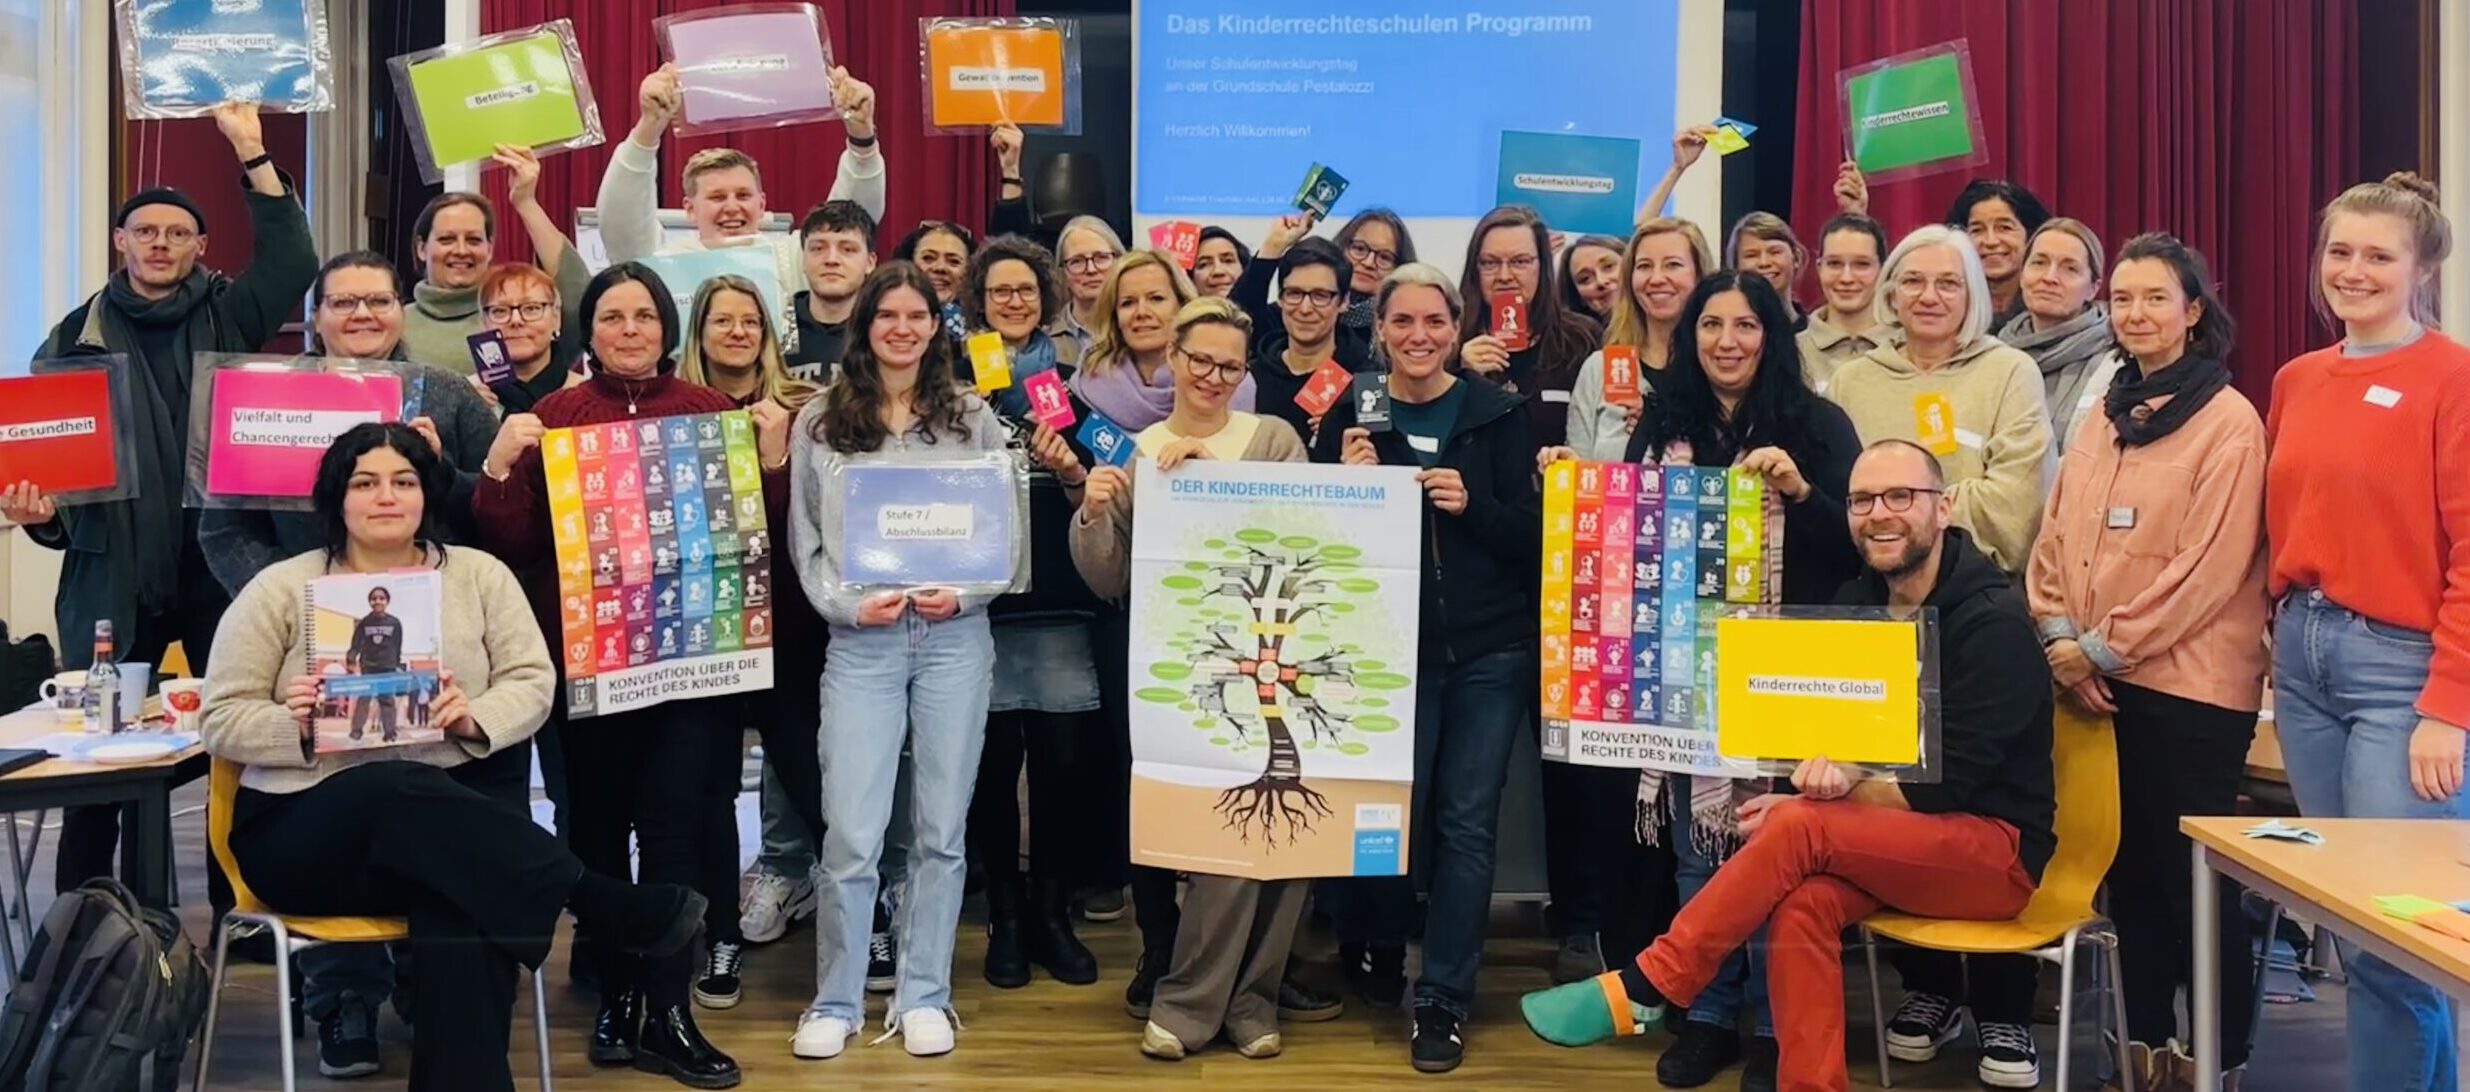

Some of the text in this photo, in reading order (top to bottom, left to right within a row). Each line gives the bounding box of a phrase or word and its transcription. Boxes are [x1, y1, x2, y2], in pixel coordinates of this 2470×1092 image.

[1167, 13, 1592, 37] Das Kinderrechteschulen Programm
[1166, 57, 1358, 72] Unser Schulentwicklungstag
[1165, 80, 1374, 93] an der Grundschule Pestalozzi
[1165, 125, 1311, 137] Herzlich Willkommen!
[1518, 176, 1612, 189] Schulentwicklungstag
[234, 412, 312, 423] Vielfalt und
[8, 420, 93, 437] Gesundheit
[233, 432, 336, 445] Chancengerech
[1171, 480, 1385, 500] DER KINDERRECHTEBAUM
[886, 510, 913, 520] Stufe
[916, 510, 922, 519] 7
[886, 527, 967, 537] Abschlussbilanz
[609, 657, 760, 691] KONVENTION ÜBER DIE
[609, 673, 741, 705] RECHTE DES KINDES
[1749, 678, 1884, 695] Kinderrechte Global
[1581, 730, 1715, 751] KONVENTION ÜBER
[1581, 744, 1634, 758] RECHTE
[1639, 748, 1665, 761] DES
[1669, 752, 1721, 767] KINDES
